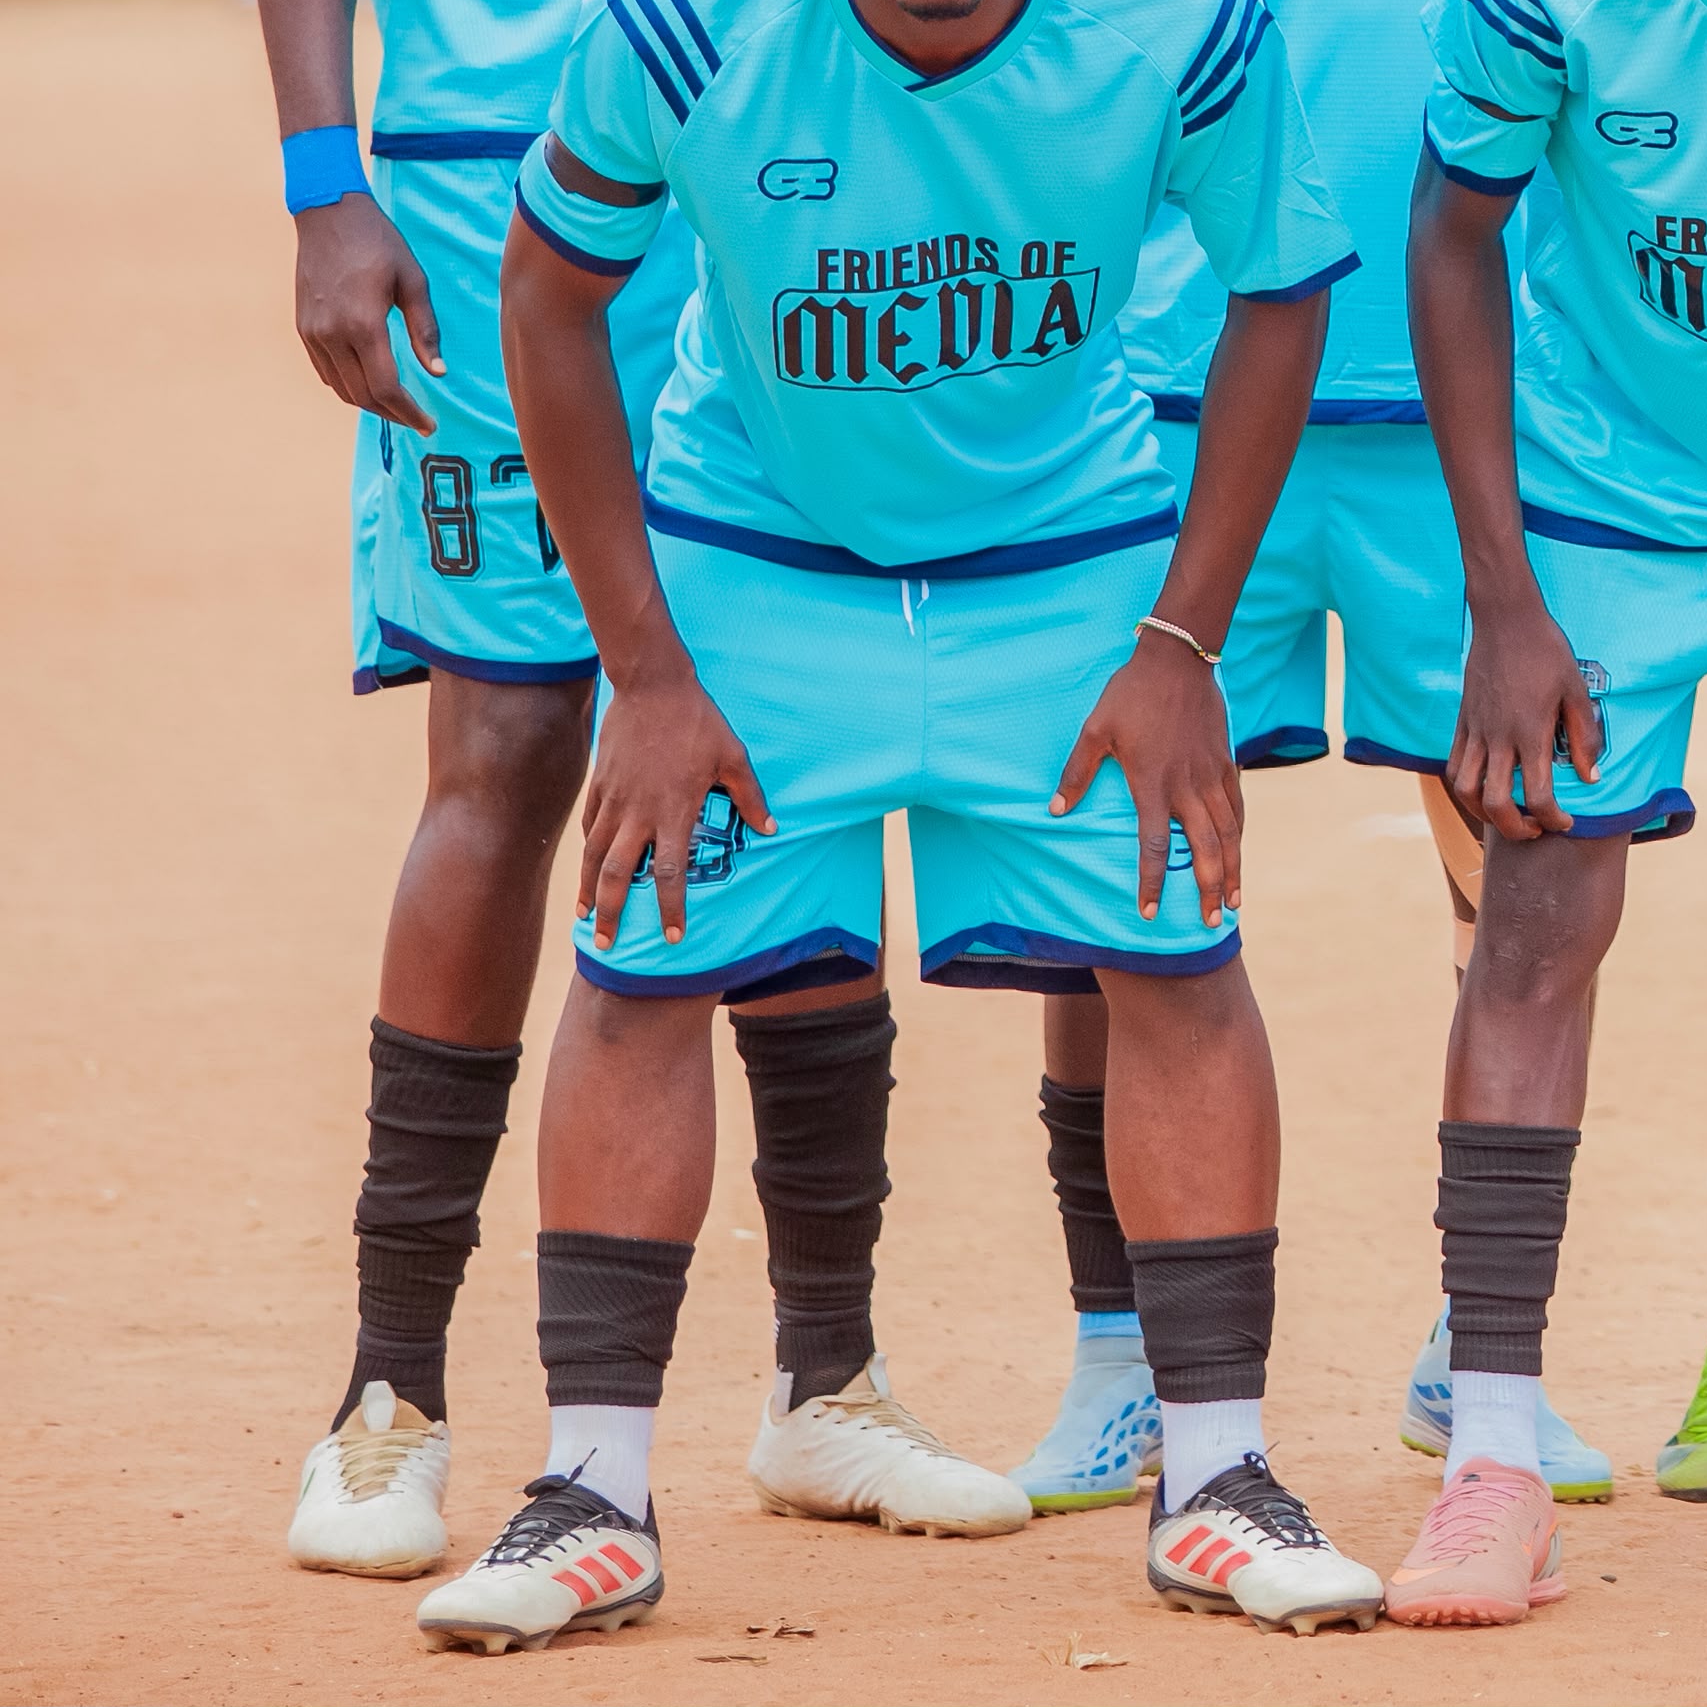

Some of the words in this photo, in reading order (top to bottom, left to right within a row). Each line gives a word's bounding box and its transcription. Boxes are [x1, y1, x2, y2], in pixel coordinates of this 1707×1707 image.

[817, 233, 999, 292] FRIENDS
[1020, 241, 1077, 278] OF
[783, 277, 1087, 385] MEDIA
